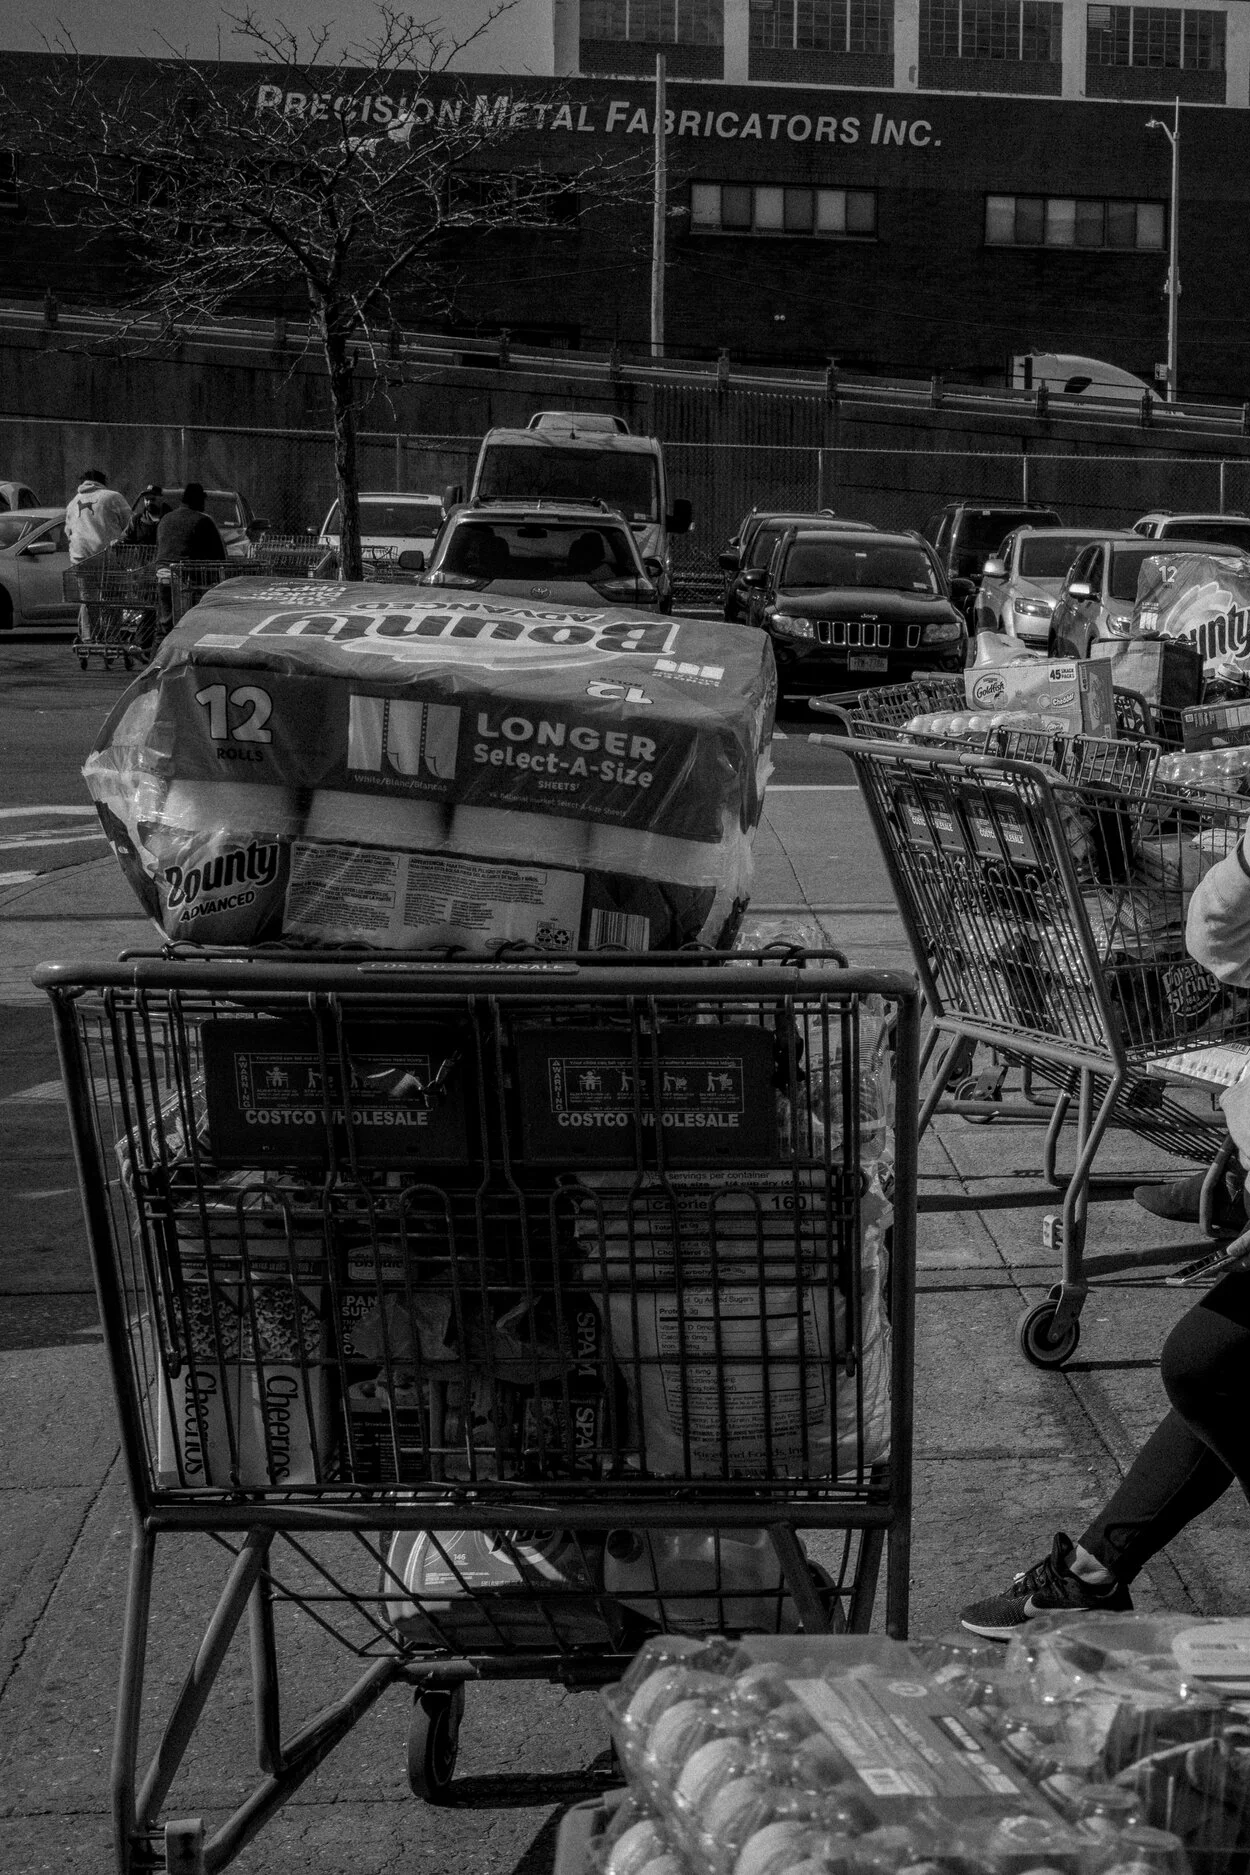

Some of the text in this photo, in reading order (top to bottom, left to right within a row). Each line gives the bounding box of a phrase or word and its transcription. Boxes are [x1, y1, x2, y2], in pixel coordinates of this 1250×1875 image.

[472, 94, 596, 131] METAL
[604, 100, 861, 144] FABRICATORS
[870, 106, 942, 146] INC.
[1158, 565, 1177, 582] 12
[354, 600, 607, 624] ADVANCED
[250, 609, 677, 656] Bounty
[1049, 669, 1062, 680] 45
[585, 680, 655, 704] 12
[976, 681, 1005, 699] Goldfish
[195, 683, 273, 744] 12
[477, 712, 657, 761] LONGER
[216, 748, 263, 762] ROLLS
[473, 743, 653, 788] Select-A-Size
[354, 774, 449, 792] White/Blanc/Blancas
[165, 840, 280, 908] Bounty
[180, 890, 256, 922] ADVANCED
[245, 1110, 429, 1126] COSTCO WHOLESALE
[557, 1113, 740, 1128] COSTCO WHOLESALE
[727, 1171, 770, 1180] container
[770, 1195, 807, 1210] 160
[576, 1311, 598, 1378] SPAM
[184, 1371, 217, 1475] Cheerios
[266, 1375, 299, 1479] Cheerios
[574, 1406, 596, 1471] SPAM
